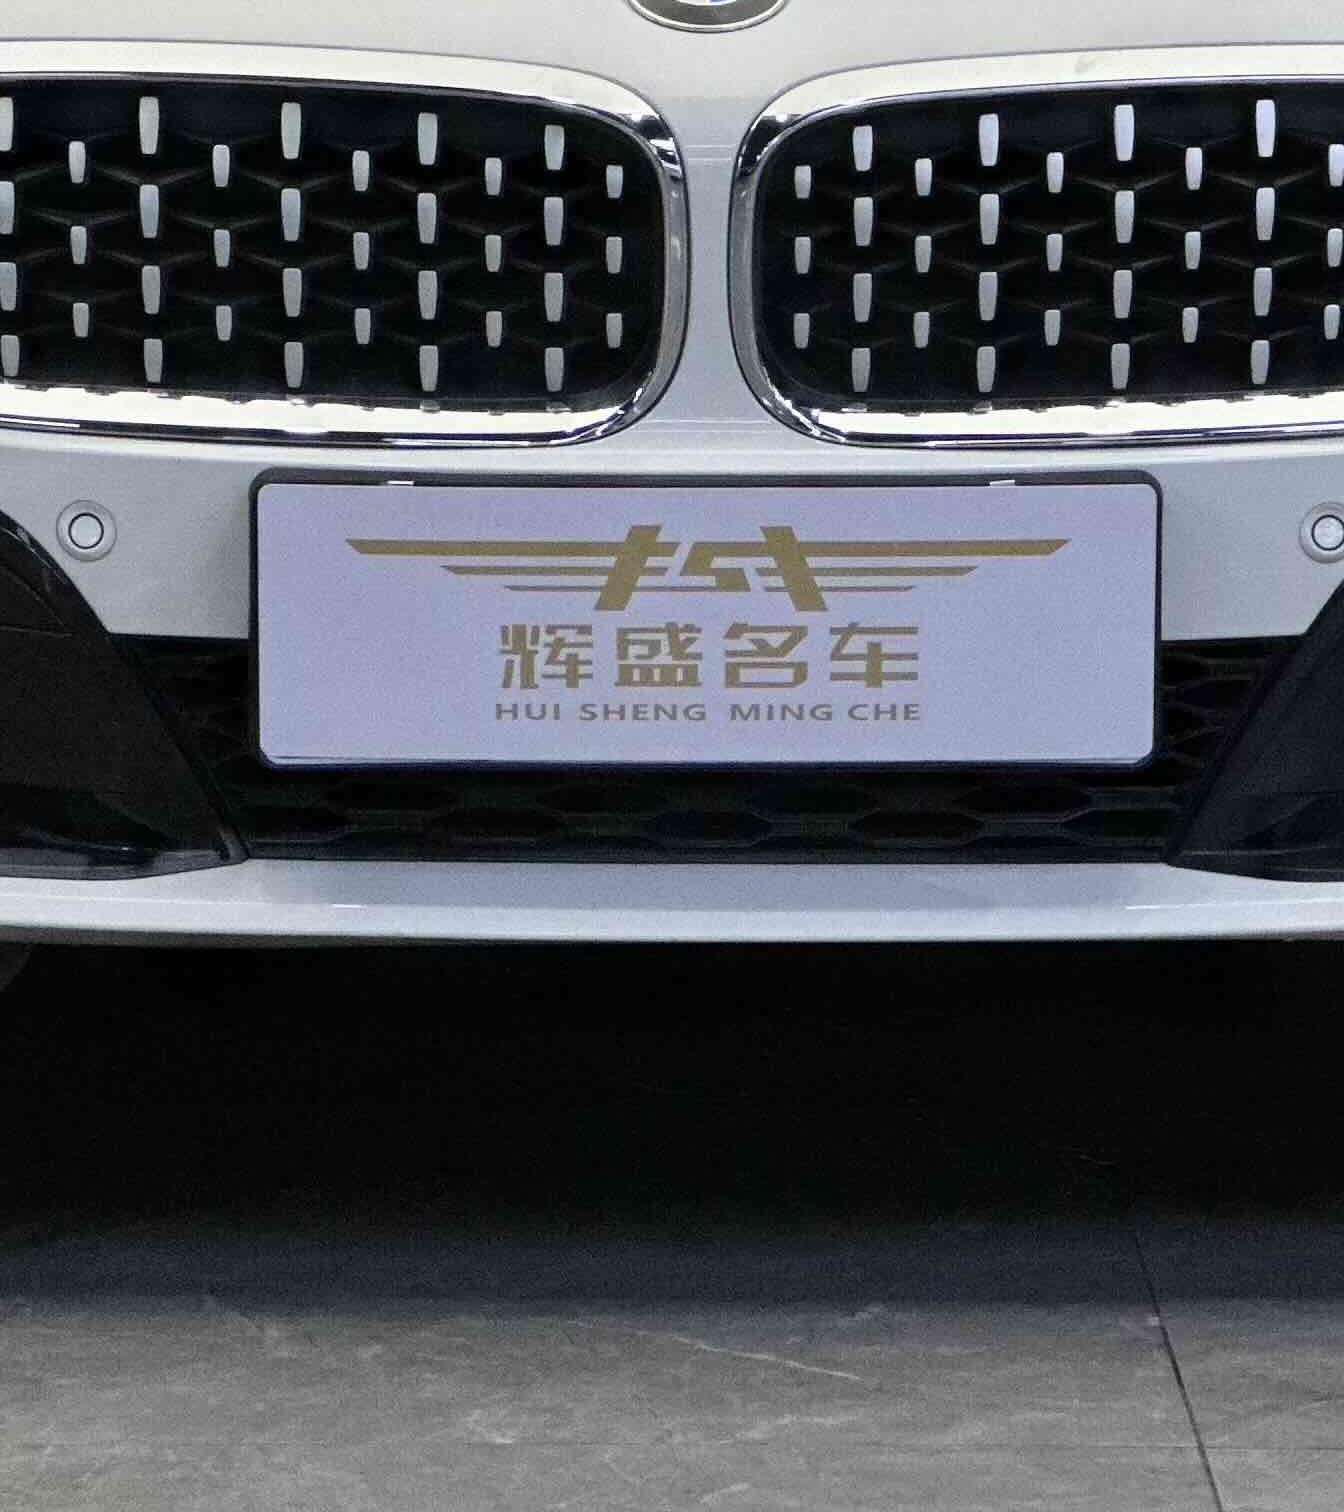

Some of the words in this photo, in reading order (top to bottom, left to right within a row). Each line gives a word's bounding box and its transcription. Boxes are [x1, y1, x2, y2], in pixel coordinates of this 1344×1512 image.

[499, 621, 920, 689] 辉盛名车
[494, 702, 562, 721] HUI
[578, 702, 707, 722] SHENG
[729, 702, 834, 722] MING
[847, 702, 922, 721] CHE
